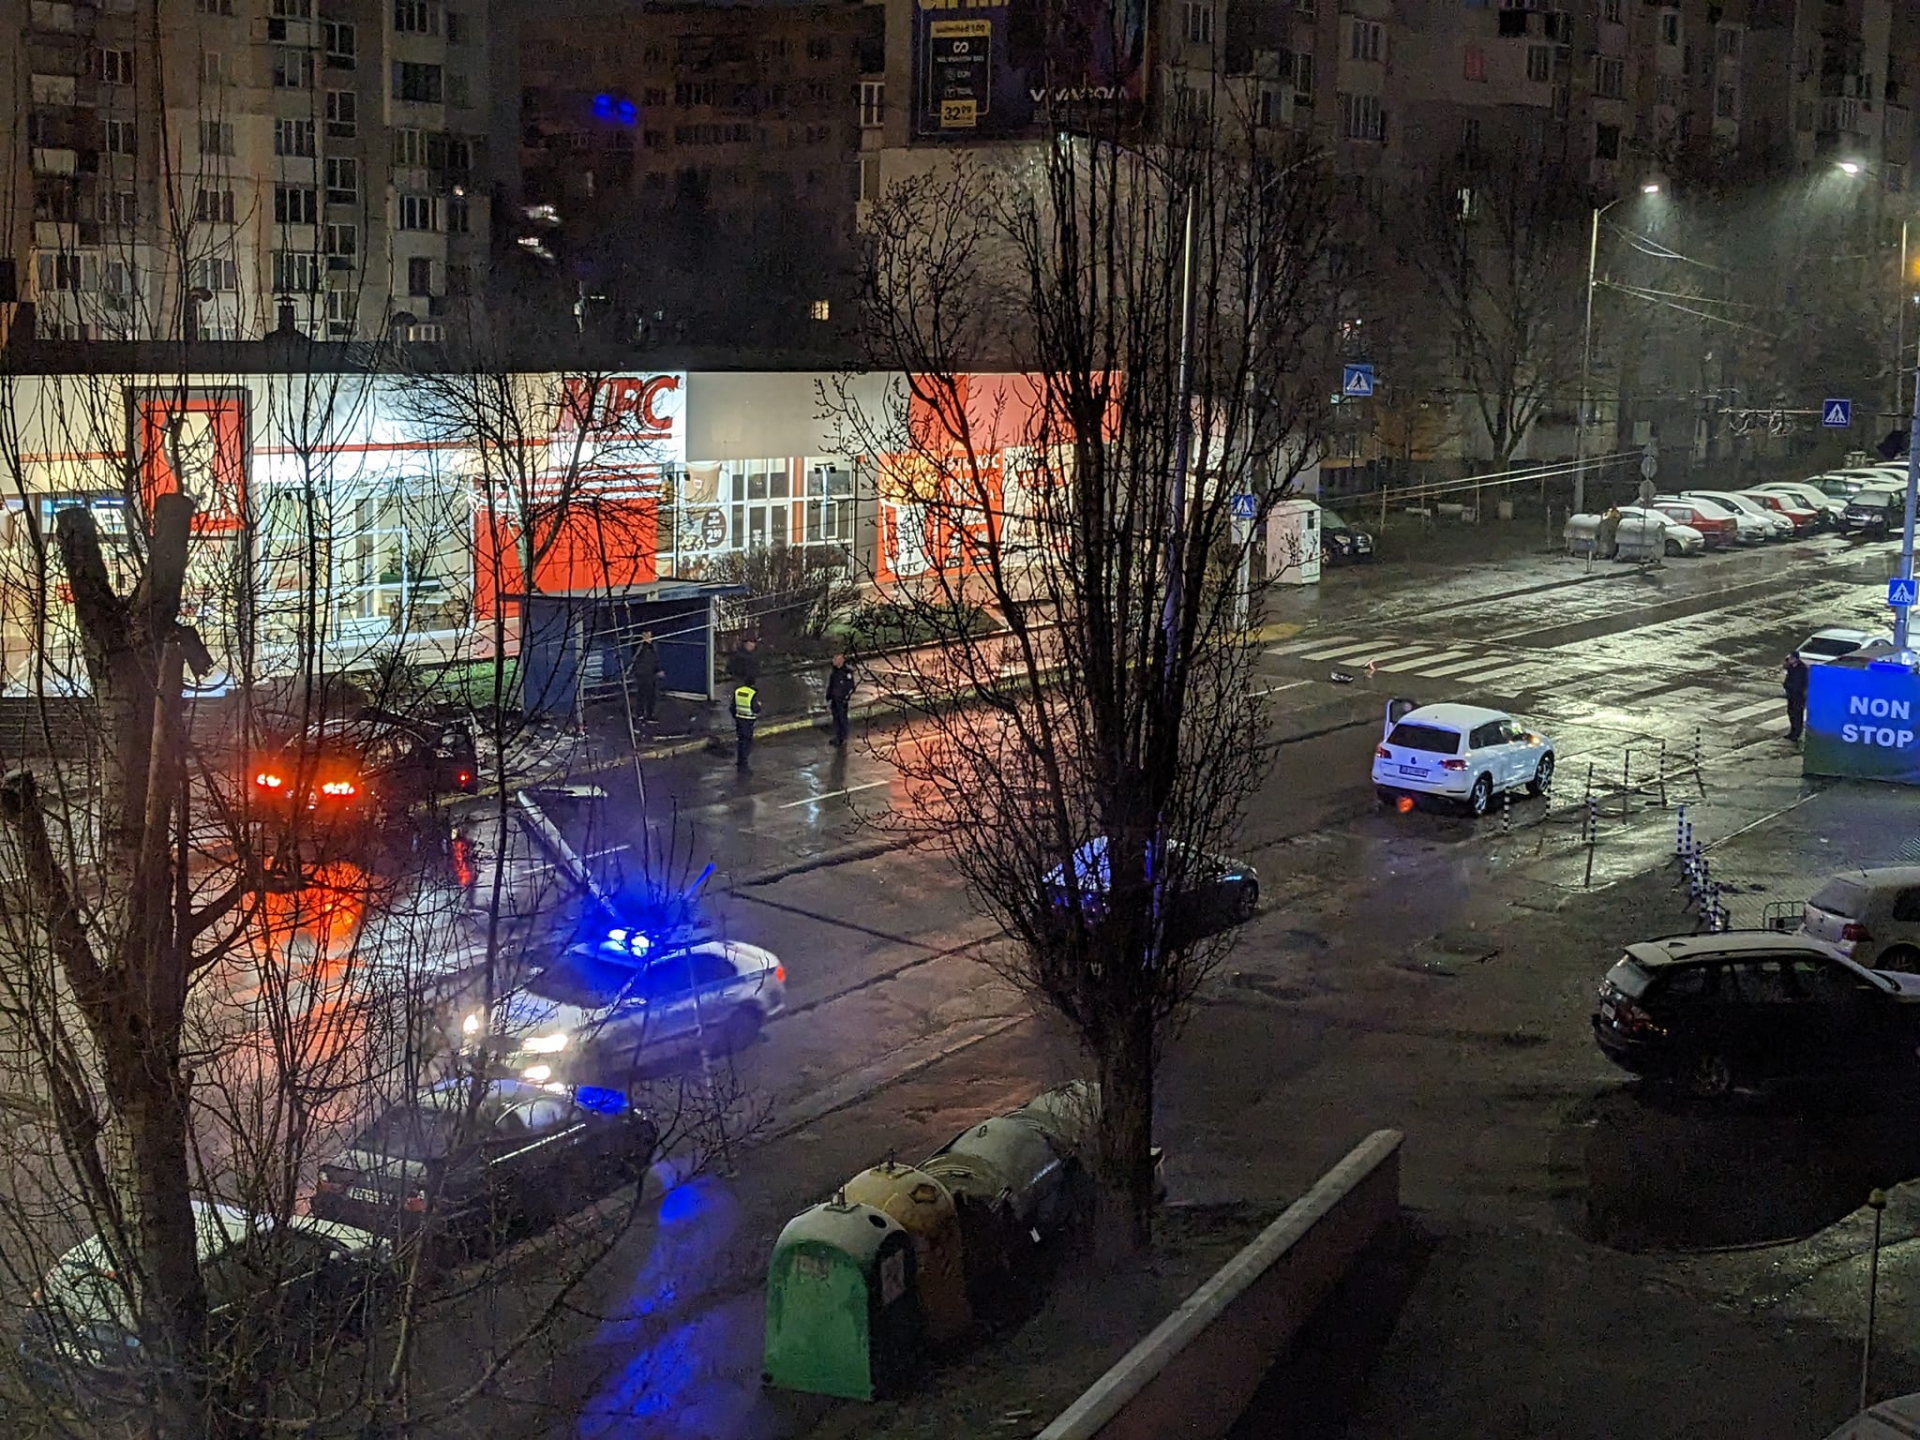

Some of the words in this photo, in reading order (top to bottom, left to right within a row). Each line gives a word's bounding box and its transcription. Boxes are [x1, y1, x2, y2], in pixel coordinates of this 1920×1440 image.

[1029, 86, 1129, 102] VVAOM
[554, 375, 677, 431] KFC
[901, 562, 920, 574] KFC
[1849, 696, 1910, 719] NON
[1842, 724, 1914, 748] STOP
